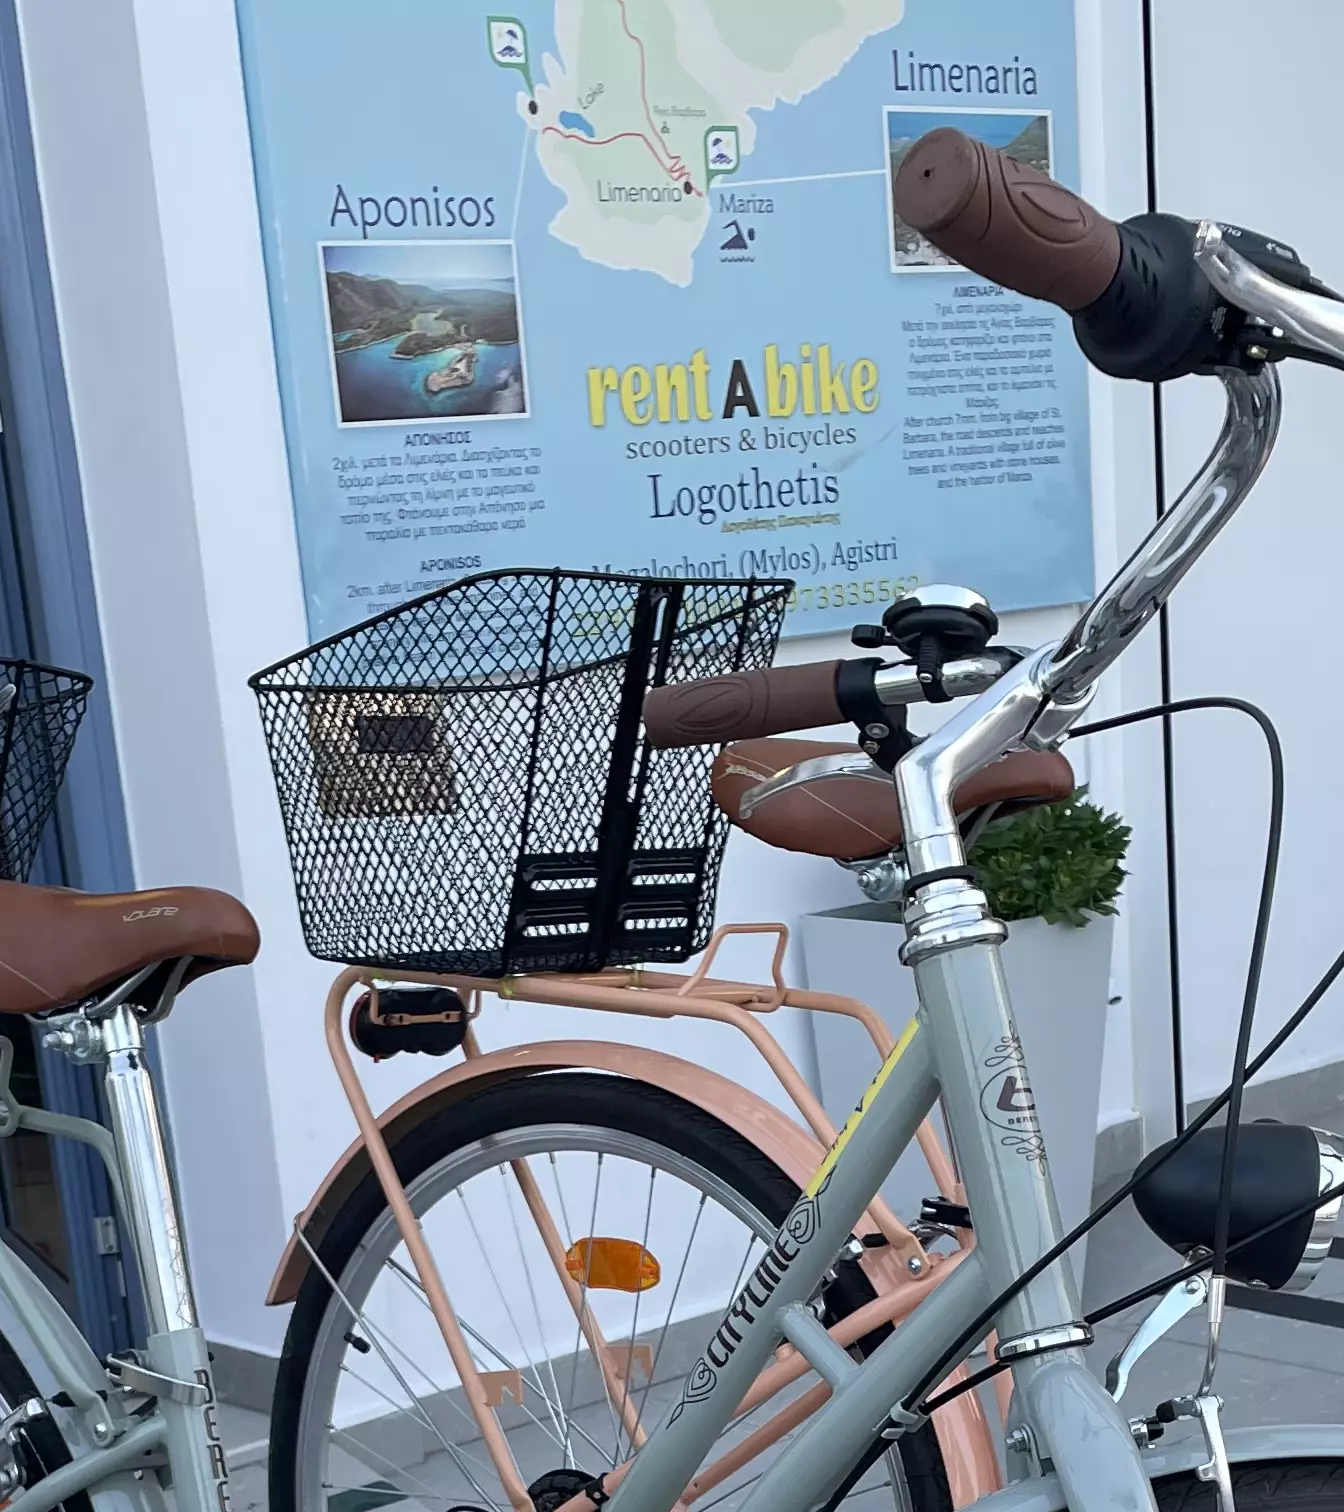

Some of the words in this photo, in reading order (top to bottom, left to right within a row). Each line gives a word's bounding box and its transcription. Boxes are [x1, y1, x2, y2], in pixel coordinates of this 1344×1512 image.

[891, 49, 1039, 97] Limenaria
[329, 184, 496, 239] Aponisos
[719, 193, 774, 215] Mariza
[586, 347, 714, 427] rent
[722, 358, 762, 420] A
[764, 343, 880, 419] bike
[625, 434, 731, 460] scooters
[737, 427, 757, 453] &
[763, 422, 859, 454] bicycles
[645, 463, 840, 525] Logothetis
[738, 545, 827, 580] (Mylos),
[831, 537, 898, 572] Agistri
[707, 1229, 801, 1369] CITYLINE
